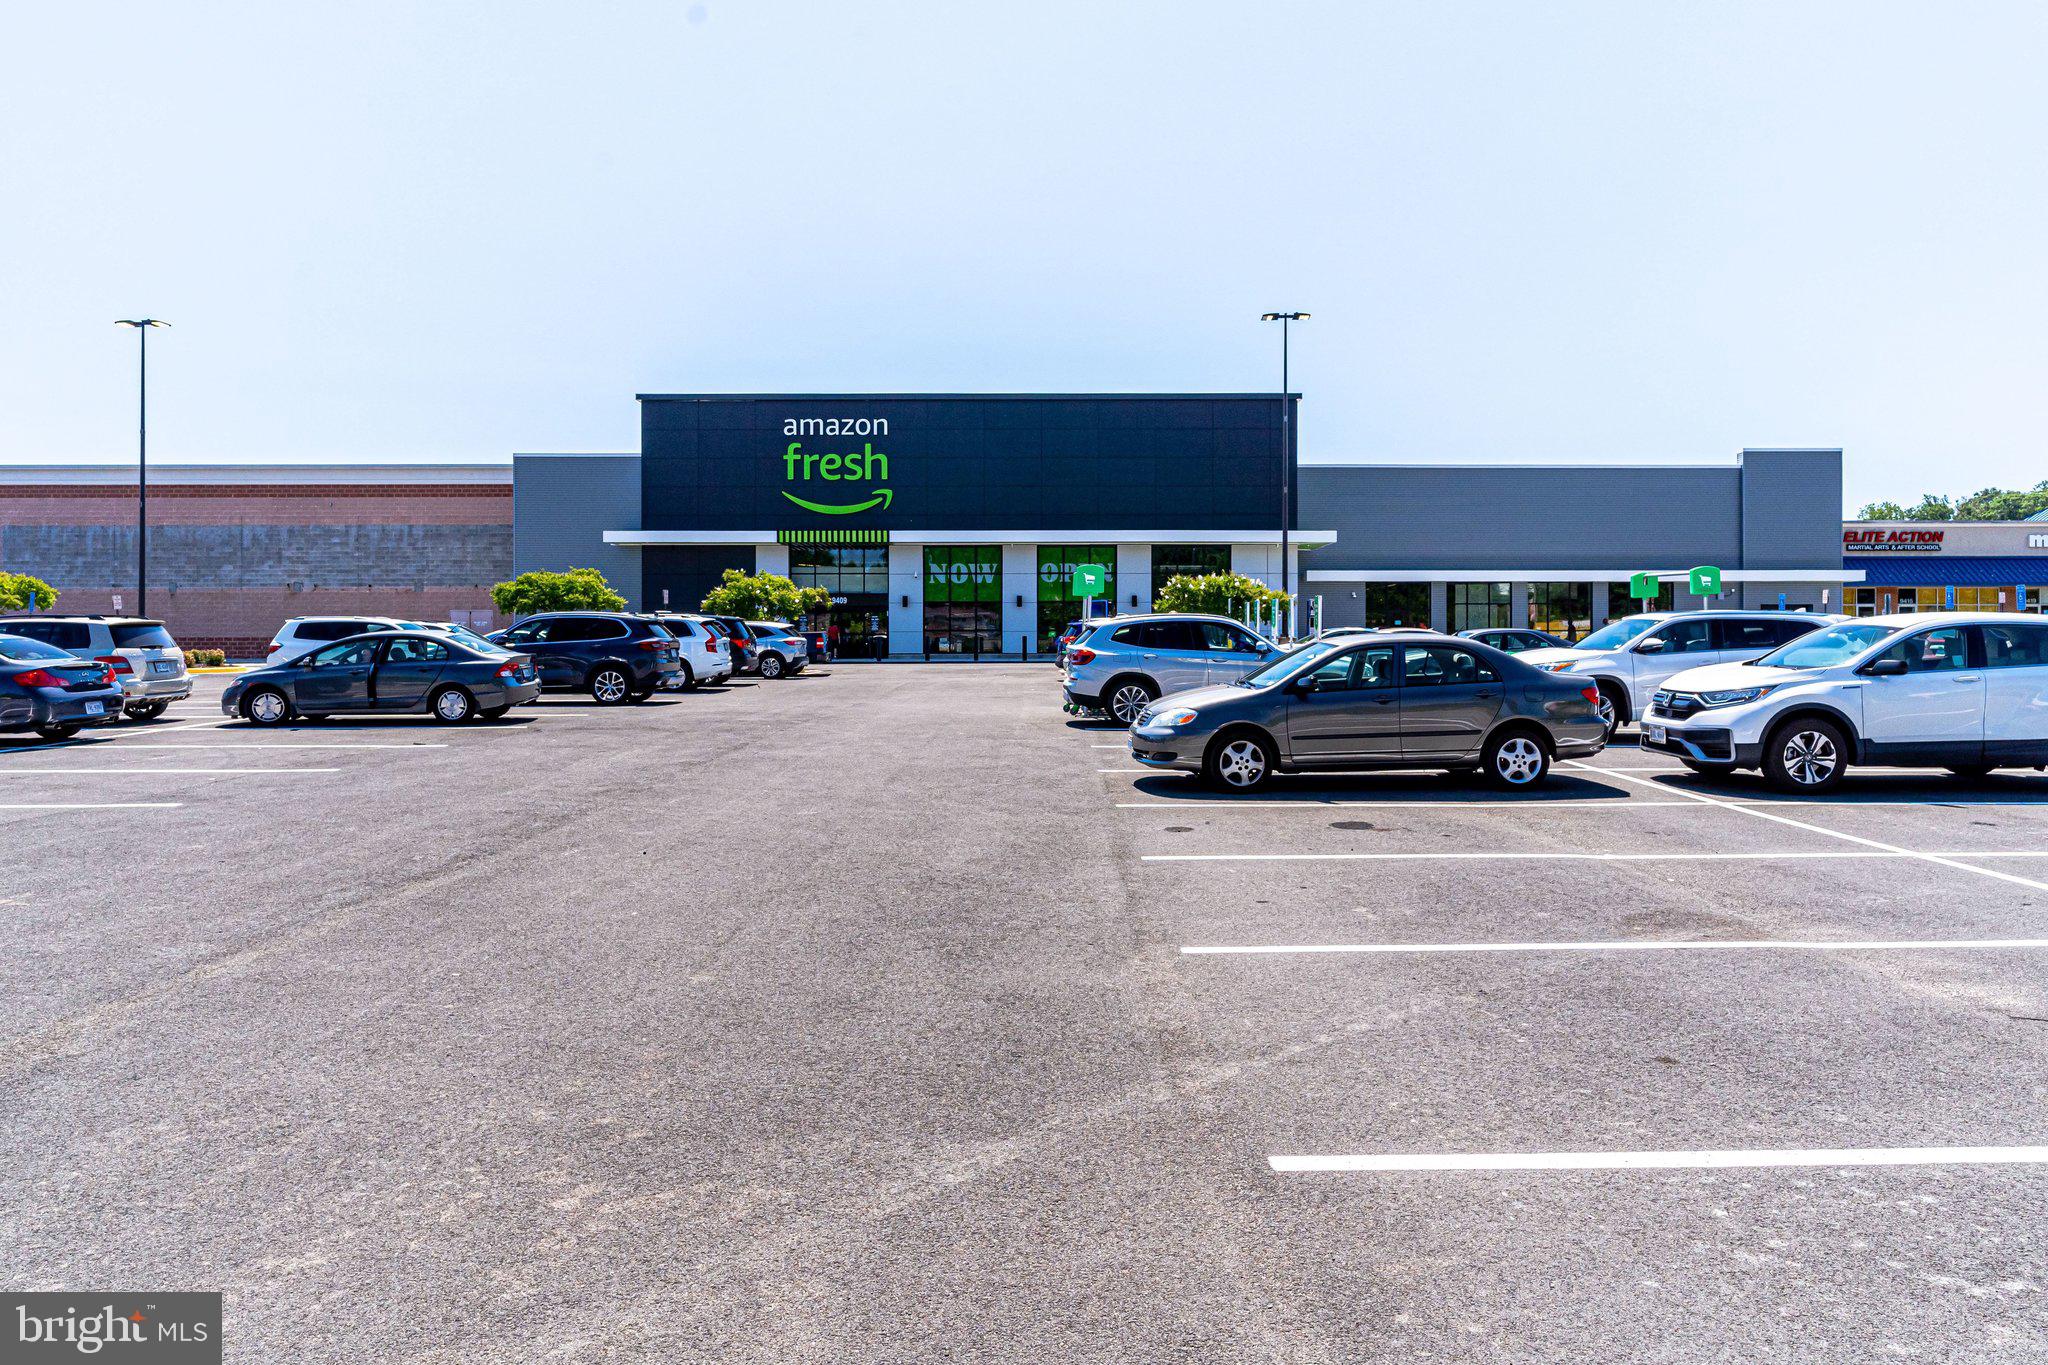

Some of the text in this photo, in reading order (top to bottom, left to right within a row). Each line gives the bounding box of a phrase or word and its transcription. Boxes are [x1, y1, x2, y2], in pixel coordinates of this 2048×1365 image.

[783, 418, 888, 436] amazon
[783, 442, 888, 481] fresh
[1843, 531, 1944, 543] ELITE ACTION
[929, 562, 1114, 584] NOW OPN
[831, 596, 848, 604] 9409
